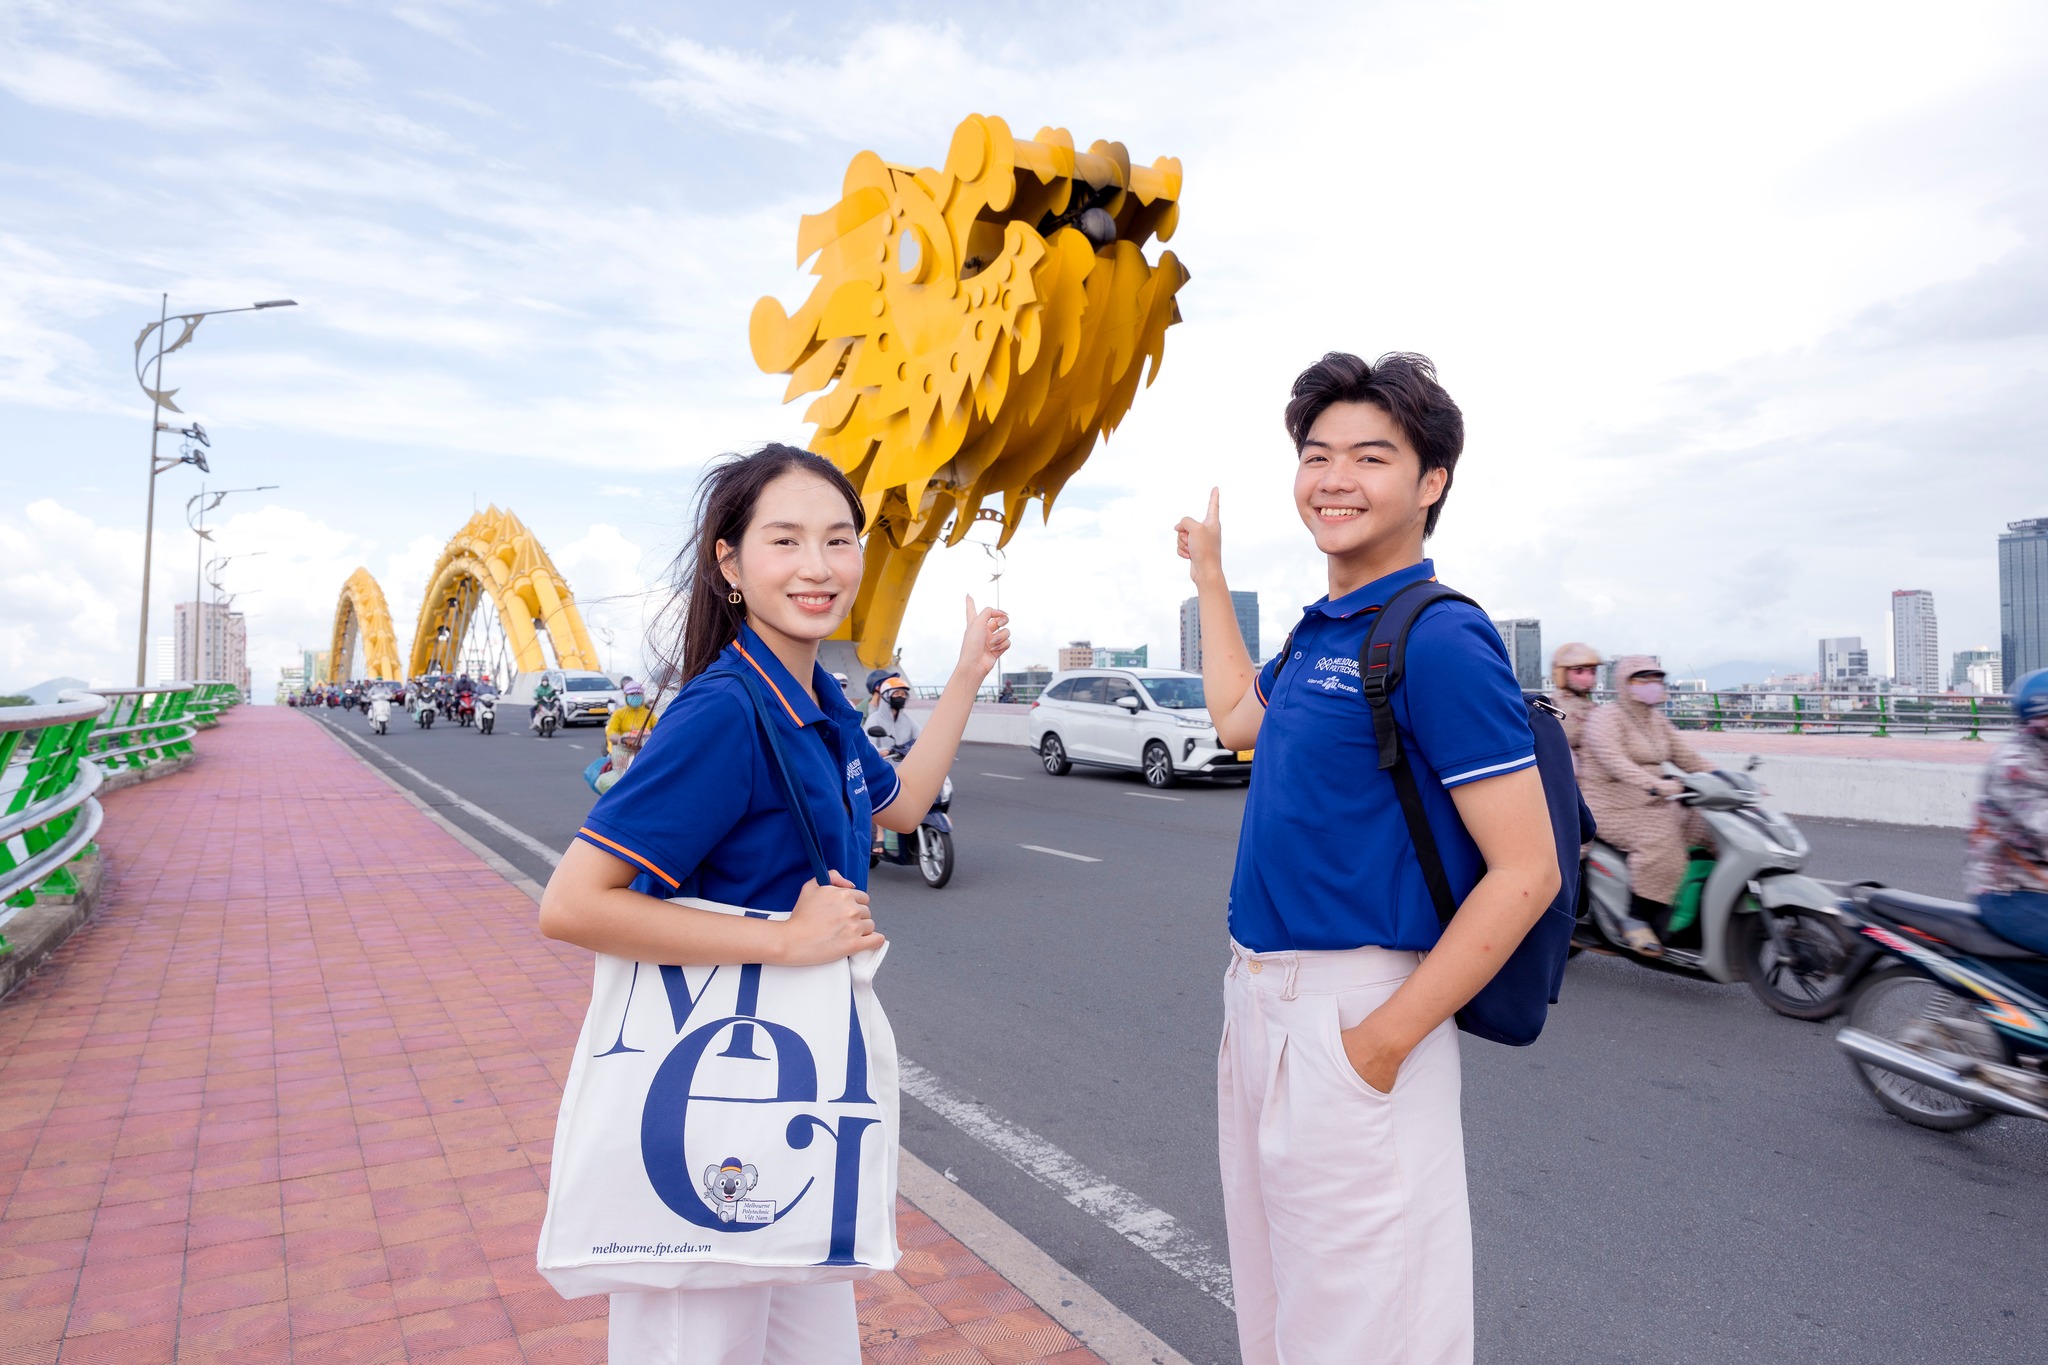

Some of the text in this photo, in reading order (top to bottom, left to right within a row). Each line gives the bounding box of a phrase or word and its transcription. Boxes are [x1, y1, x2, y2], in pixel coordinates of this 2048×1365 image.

[1337, 683, 1358, 693] Education
[742, 1208, 770, 1216] Polytechnic
[592, 1242, 712, 1256] melbourne.fpt.edu.vn
